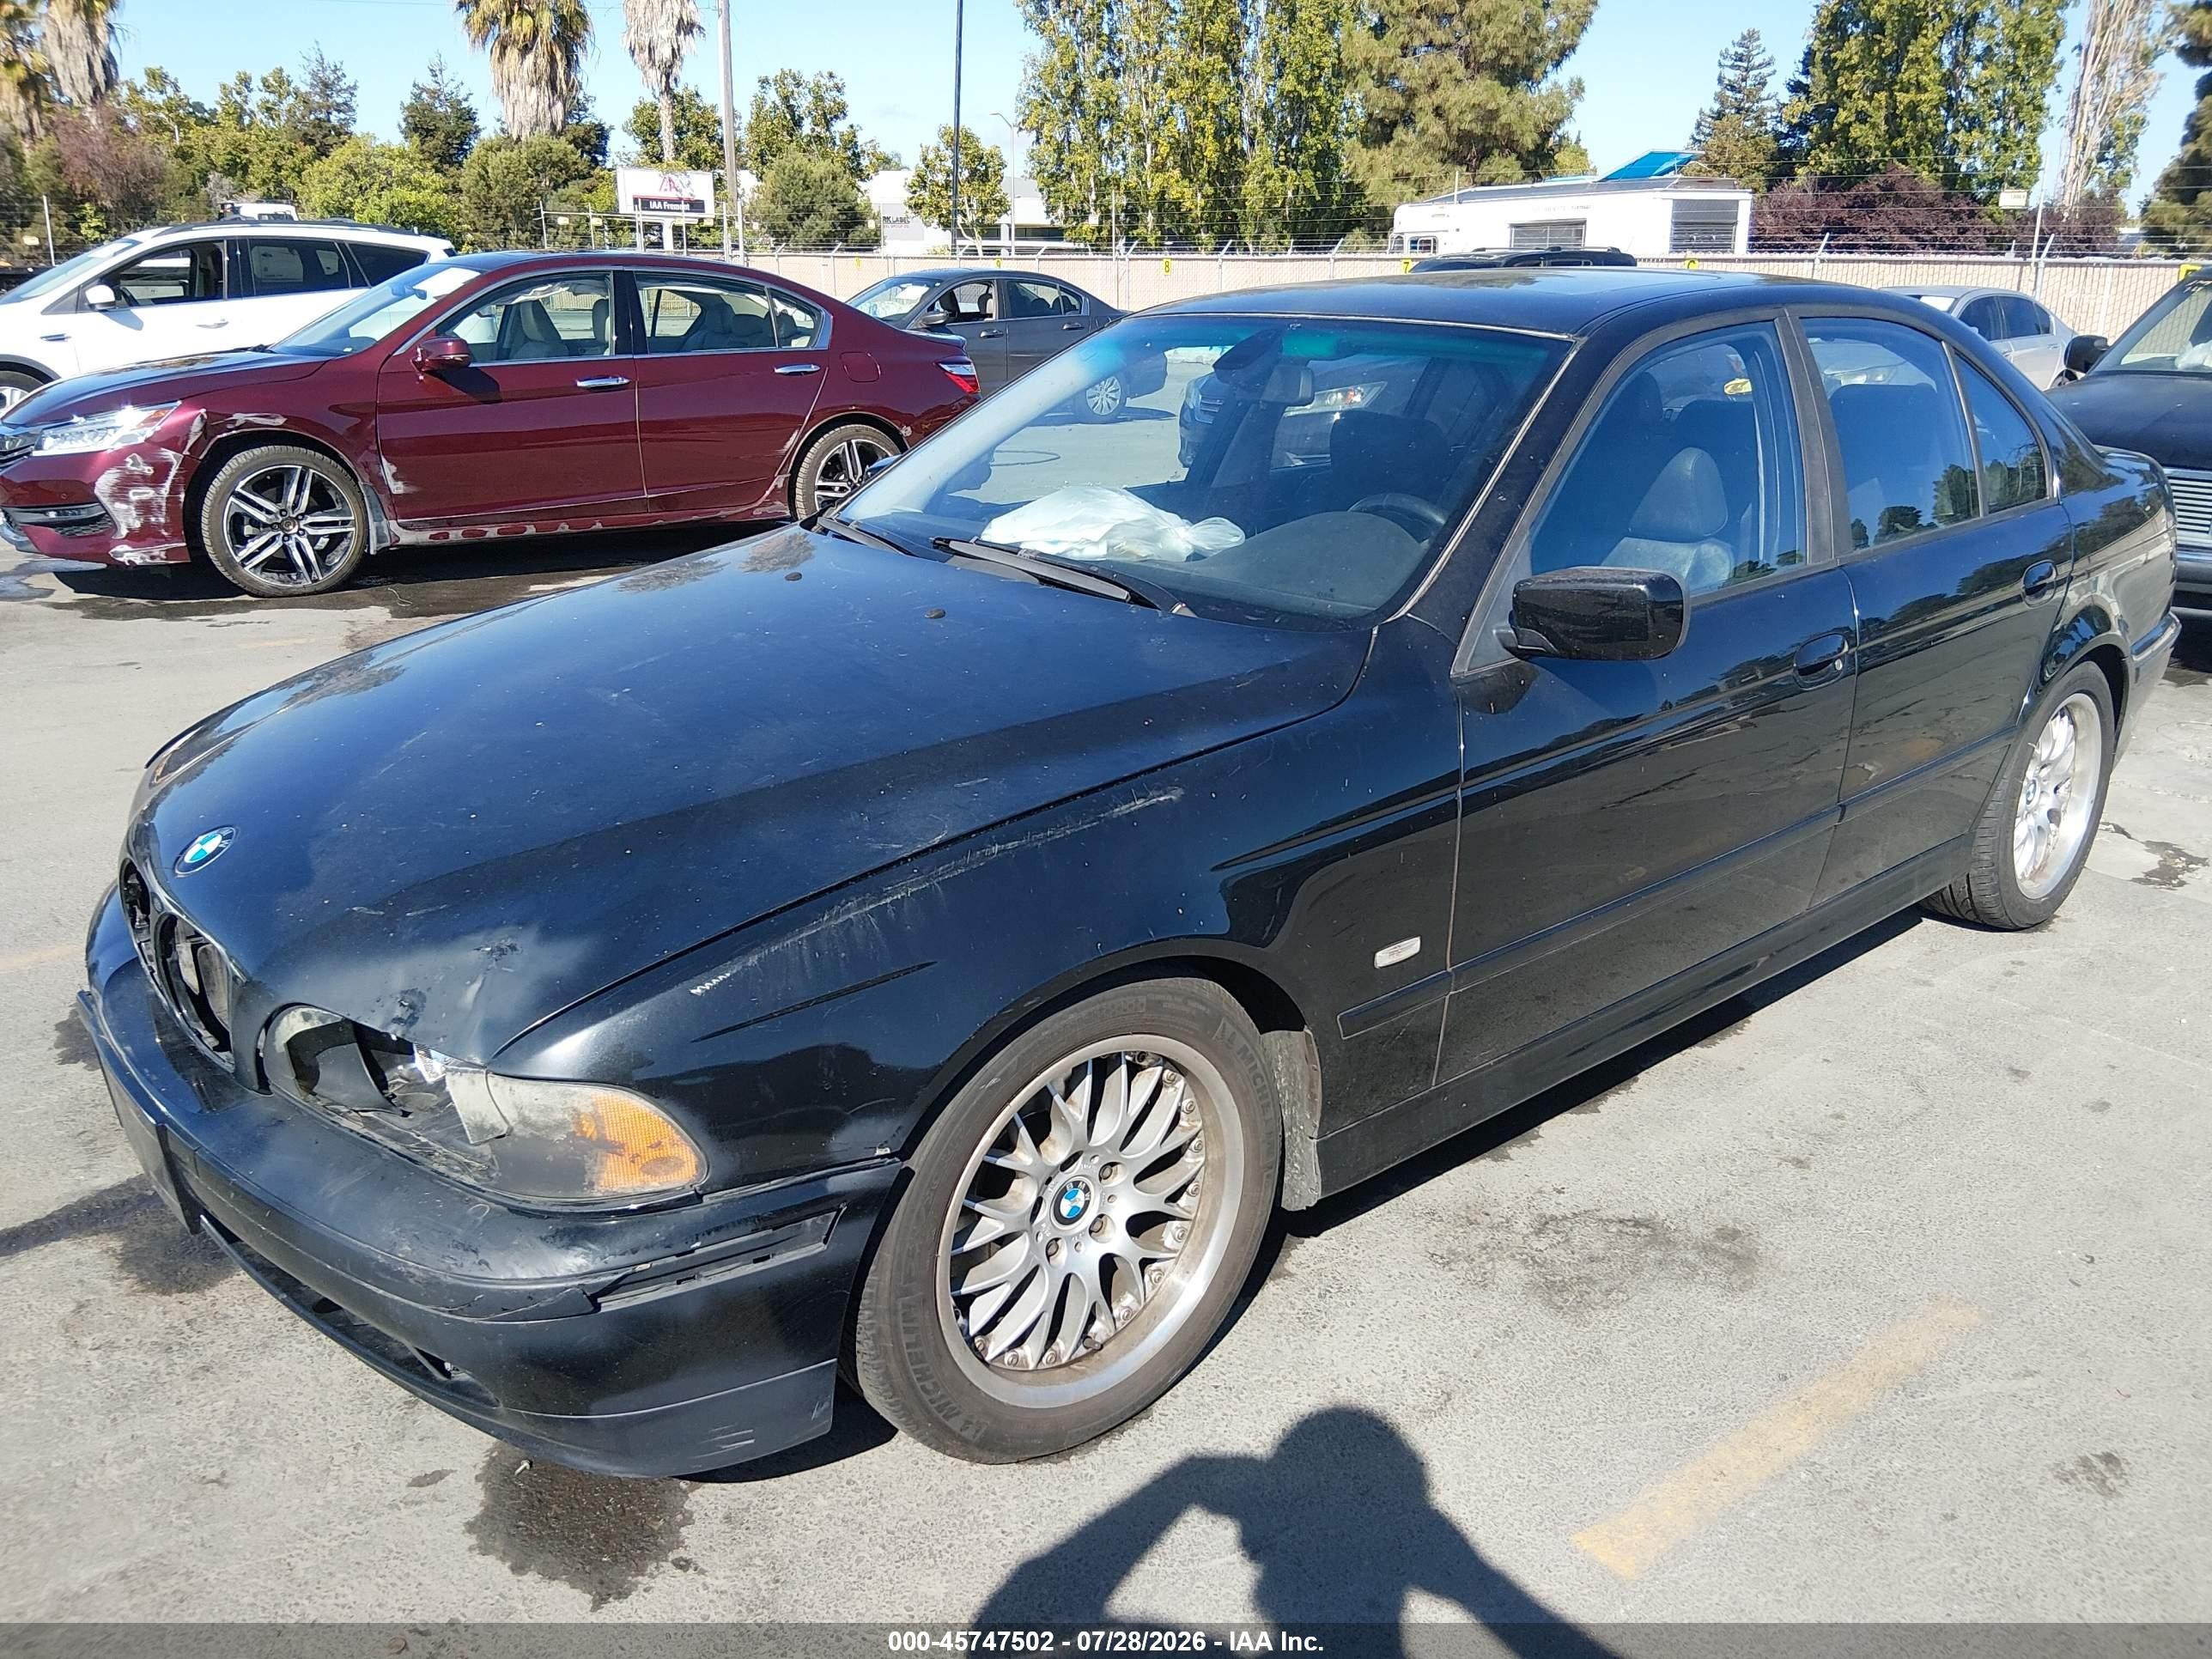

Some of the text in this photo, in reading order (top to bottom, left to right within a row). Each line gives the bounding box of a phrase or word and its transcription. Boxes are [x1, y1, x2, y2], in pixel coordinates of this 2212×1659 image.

[649, 200, 663, 210] IAA
[1164, 260, 1170, 273] 8
[1403, 261, 1410, 274] 7
[1066, 1181, 1091, 1200] BMW
[900, 1301, 962, 1422] MICHELIN
